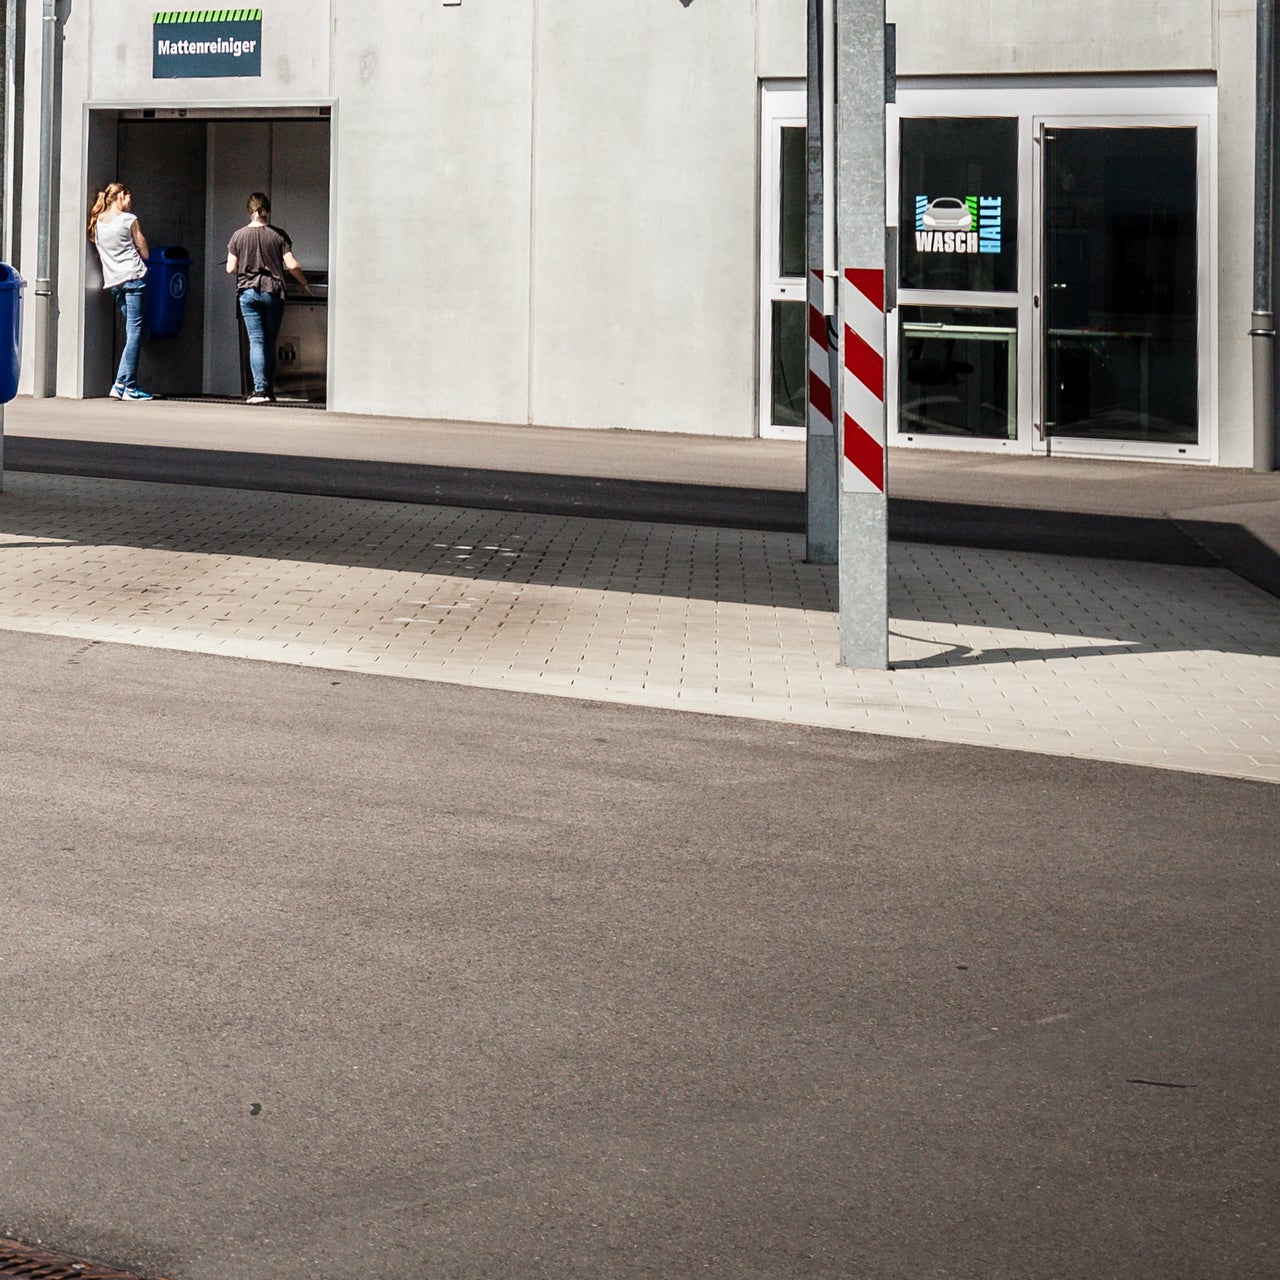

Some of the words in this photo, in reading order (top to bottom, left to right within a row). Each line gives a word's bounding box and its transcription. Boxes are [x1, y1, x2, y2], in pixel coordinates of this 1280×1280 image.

[157, 37, 257, 57] Mattenreiniger
[979, 196, 1002, 253] HALLE
[915, 231, 978, 253] WASCH
